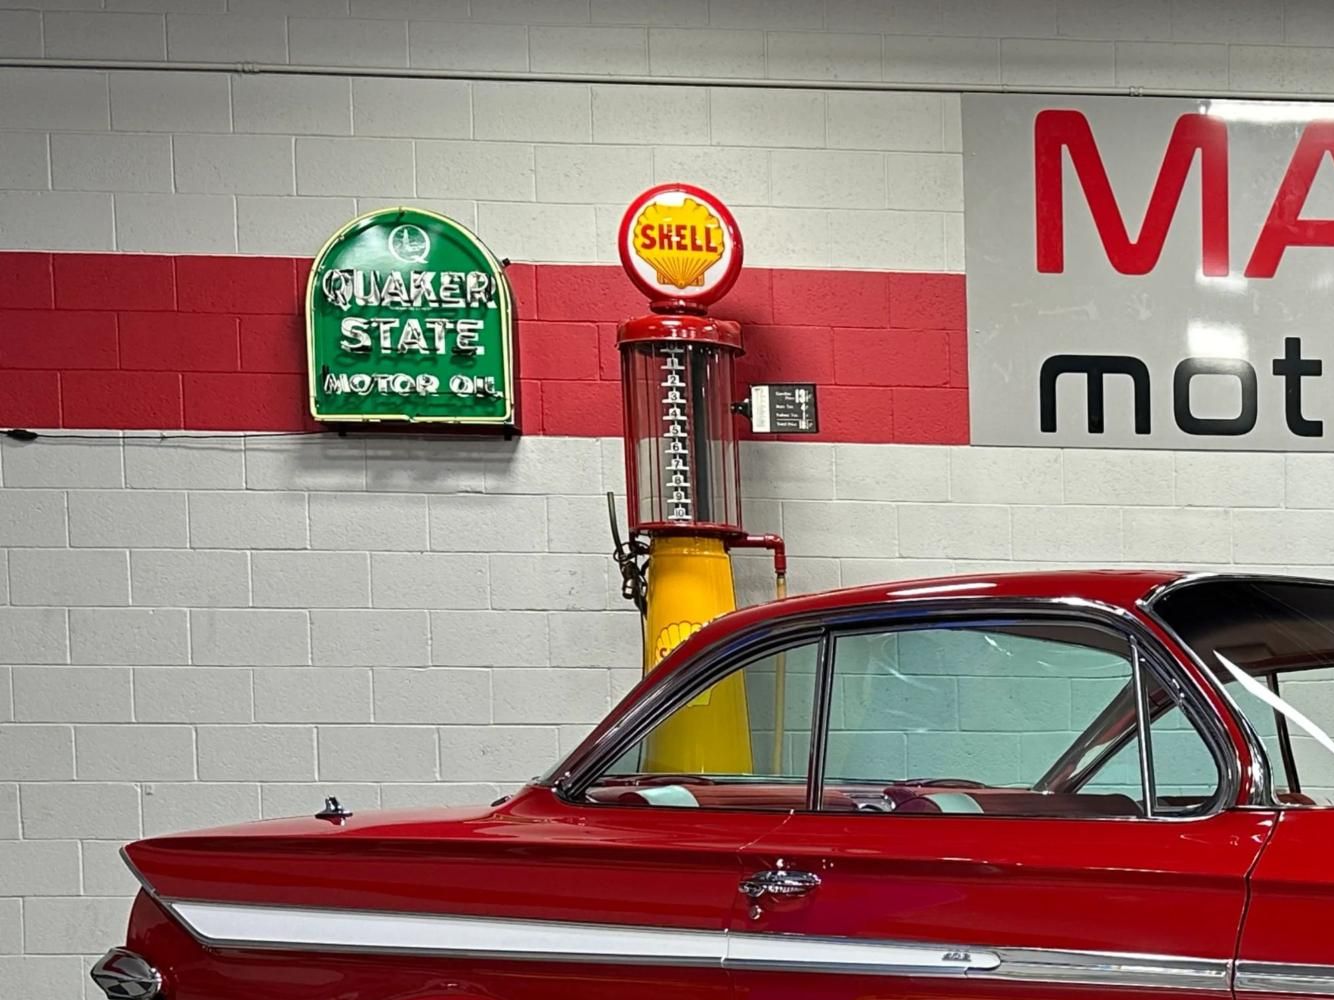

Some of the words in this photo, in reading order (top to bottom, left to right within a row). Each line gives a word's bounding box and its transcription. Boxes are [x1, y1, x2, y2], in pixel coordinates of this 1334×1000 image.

[641, 224, 718, 252] SHELL
[322, 269, 497, 310] QUAKER
[341, 317, 485, 355] STATE
[324, 373, 440, 396] MOTOR
[450, 374, 497, 396] OIL
